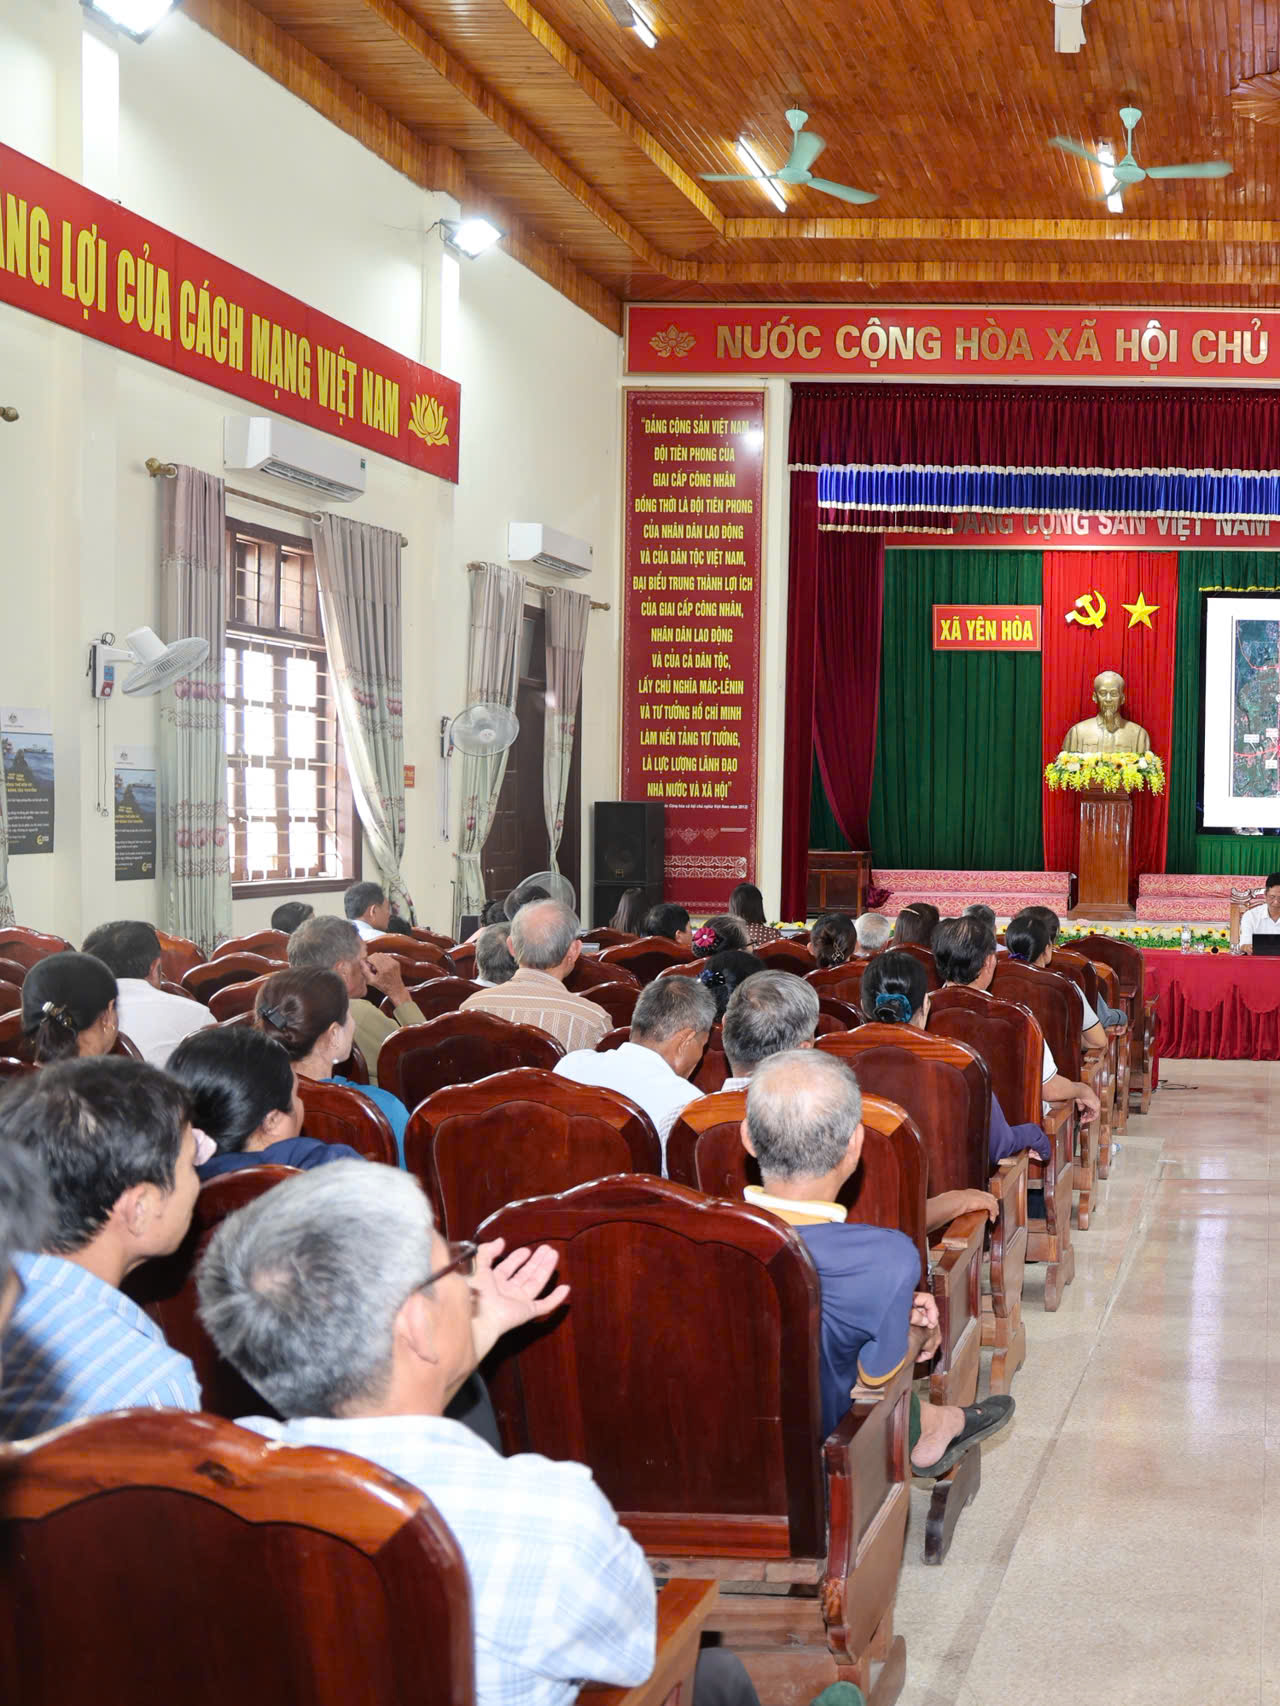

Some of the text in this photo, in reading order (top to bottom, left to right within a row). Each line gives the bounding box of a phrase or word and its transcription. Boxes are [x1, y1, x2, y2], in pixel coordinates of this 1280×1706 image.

[0, 186, 399, 439] NG LỢI CỦA CÁCH MẠNG VIỆT NAM
[716, 319, 821, 360] NƯỚC
[835, 317, 942, 368] CỘNG
[955, 320, 1034, 361] HÒA
[1045, 319, 1103, 362] XÃ
[1116, 320, 1178, 370] HỘI
[1192, 318, 1268, 364] CHỦ
[655, 441, 735, 465] ĐỘI TIÊN PHONG CỦA
[654, 467, 735, 487] GIAI CẤP CÔNG NHÂN
[635, 492, 753, 516] ĐỒNG THỜI LÀ ĐỘI TIÊN PHONG
[644, 518, 743, 543] CỦA NHÂN DÂN LAO ĐỘNG
[641, 544, 745, 569] VÀ CỦA DÂN TỘC VIỆT NAM,
[633, 570, 752, 595] ĐẠI BIỂU TRUNG THÀNH LỢI ÍCH
[642, 596, 744, 619] CỦA GIAI CẤP CÔNG NHÂN,
[940, 614, 1034, 642] XÃ YÊN HÒA
[653, 651, 661, 668] VÀ
[665, 648, 679, 668] CỦA
[683, 648, 692, 668] CẢ
[696, 651, 711, 668] DÂN
[640, 699, 741, 720] VÀ TƯ TƯỞNG HỒ CHÍ MINH
[641, 728, 657, 745] LÀM
[660, 725, 675, 745] NỀN
[679, 725, 698, 745] TẢNG
[701, 730, 710, 745] TƯ
[643, 754, 737, 775] LÀ LỰC LƯỢNG LÃNH ĐẠO
